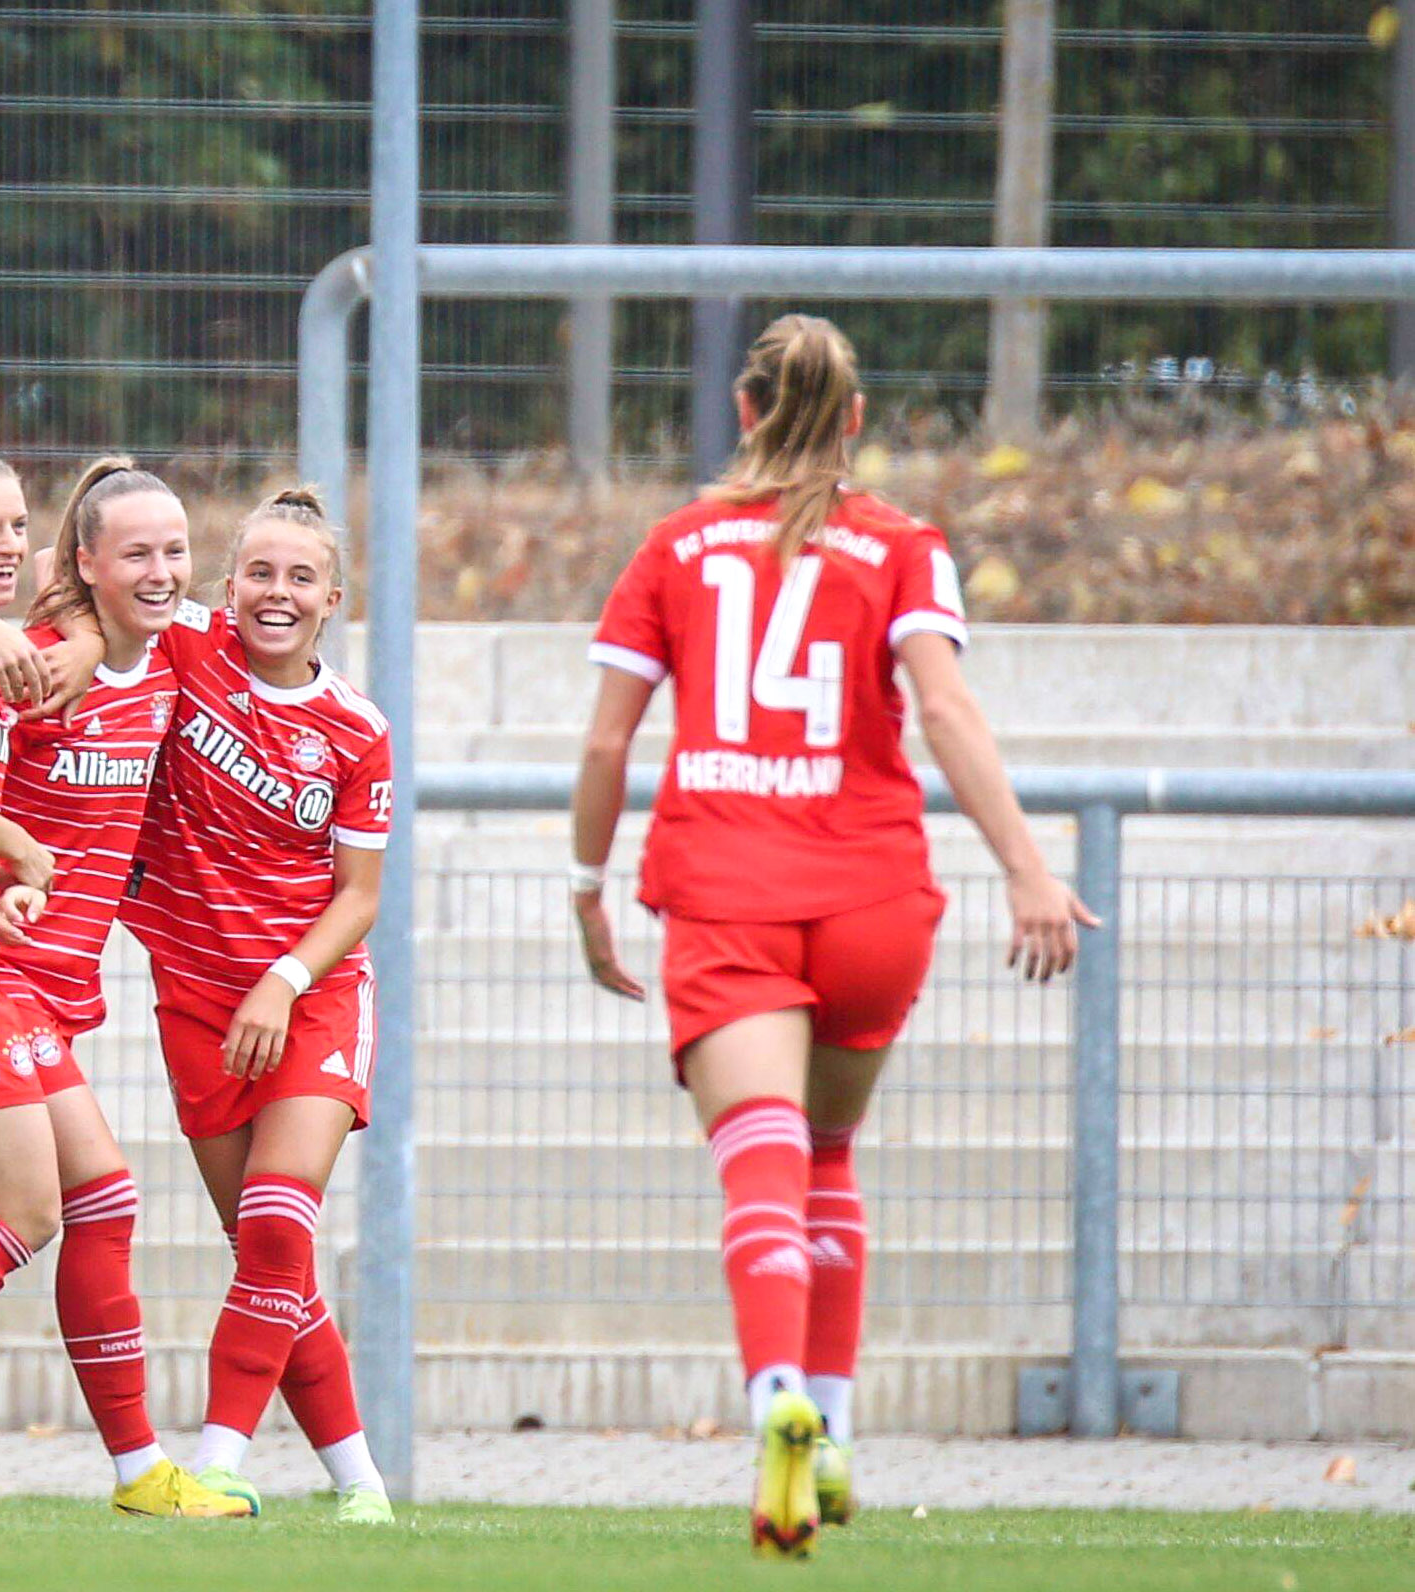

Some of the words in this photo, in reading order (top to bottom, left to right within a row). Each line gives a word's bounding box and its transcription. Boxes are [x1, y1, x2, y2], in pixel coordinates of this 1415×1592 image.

[702, 554, 844, 747] 14
[47, 748, 146, 787] Allianz
[179, 711, 293, 811] Allianz
